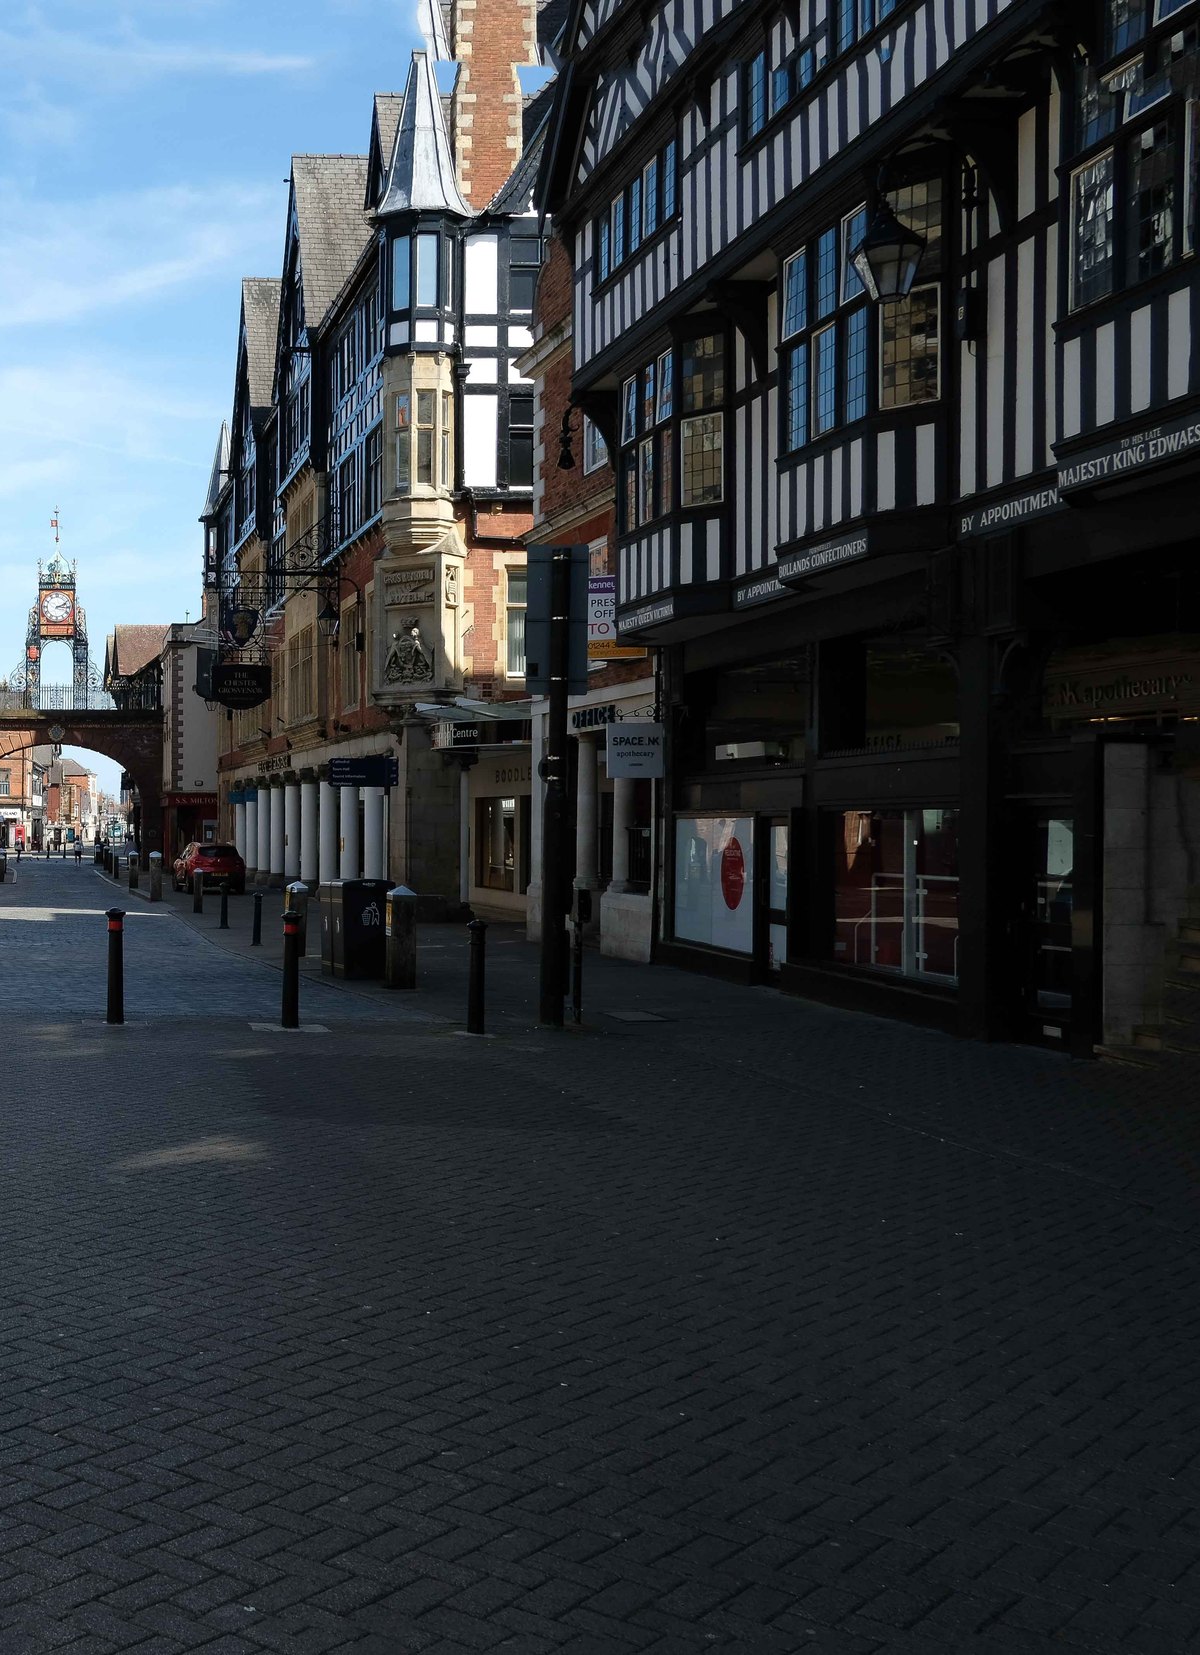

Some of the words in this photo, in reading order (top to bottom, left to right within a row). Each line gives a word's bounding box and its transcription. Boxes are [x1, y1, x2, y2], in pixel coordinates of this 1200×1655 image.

[1120, 438, 1129, 449] TO
[1132, 433, 1144, 445] HIS
[1145, 427, 1162, 440] LATE
[1057, 455, 1112, 488] MAJESTY
[1113, 444, 1146, 471] KING
[961, 515, 975, 533] BY
[980, 488, 1063, 527] APPOINTMEN
[778, 557, 810, 578] BOLLANDS
[811, 538, 867, 568] CONFECTIONERS
[737, 590, 745, 602] BY
[594, 609, 614, 618] OFF
[618, 615, 638, 631] MAJESTY
[638, 611, 654, 626] QUEEN
[654, 604, 674, 621] VICTORIA
[588, 623, 610, 635] TO
[234, 671, 249, 679] THE
[572, 704, 616, 728] OFFICE
[451, 728, 479, 739] Centre
[617, 750, 655, 758] apothecary
